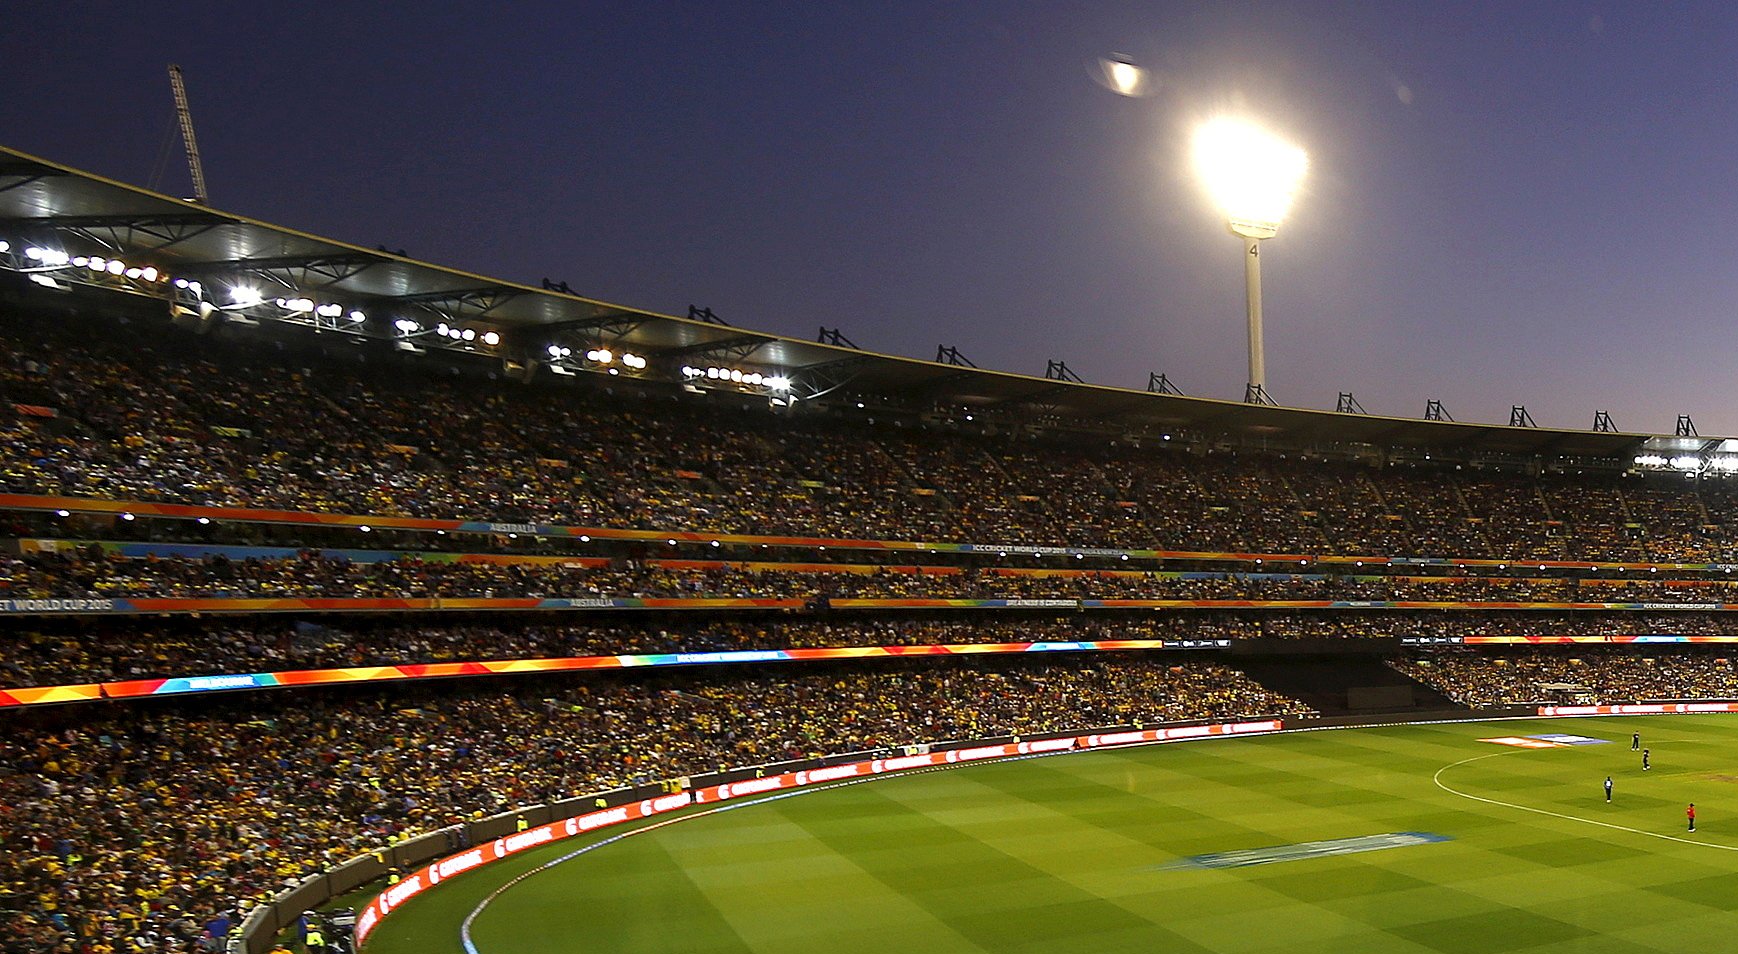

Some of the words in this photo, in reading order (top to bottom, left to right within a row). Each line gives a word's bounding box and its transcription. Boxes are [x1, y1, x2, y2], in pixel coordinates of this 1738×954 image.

[489, 523, 537, 533] AUSTRALIA
[14, 600, 60, 610] WORLD
[61, 600, 87, 610] CUP
[87, 600, 113, 610] 2015
[570, 598, 615, 607] AUSTRALIA
